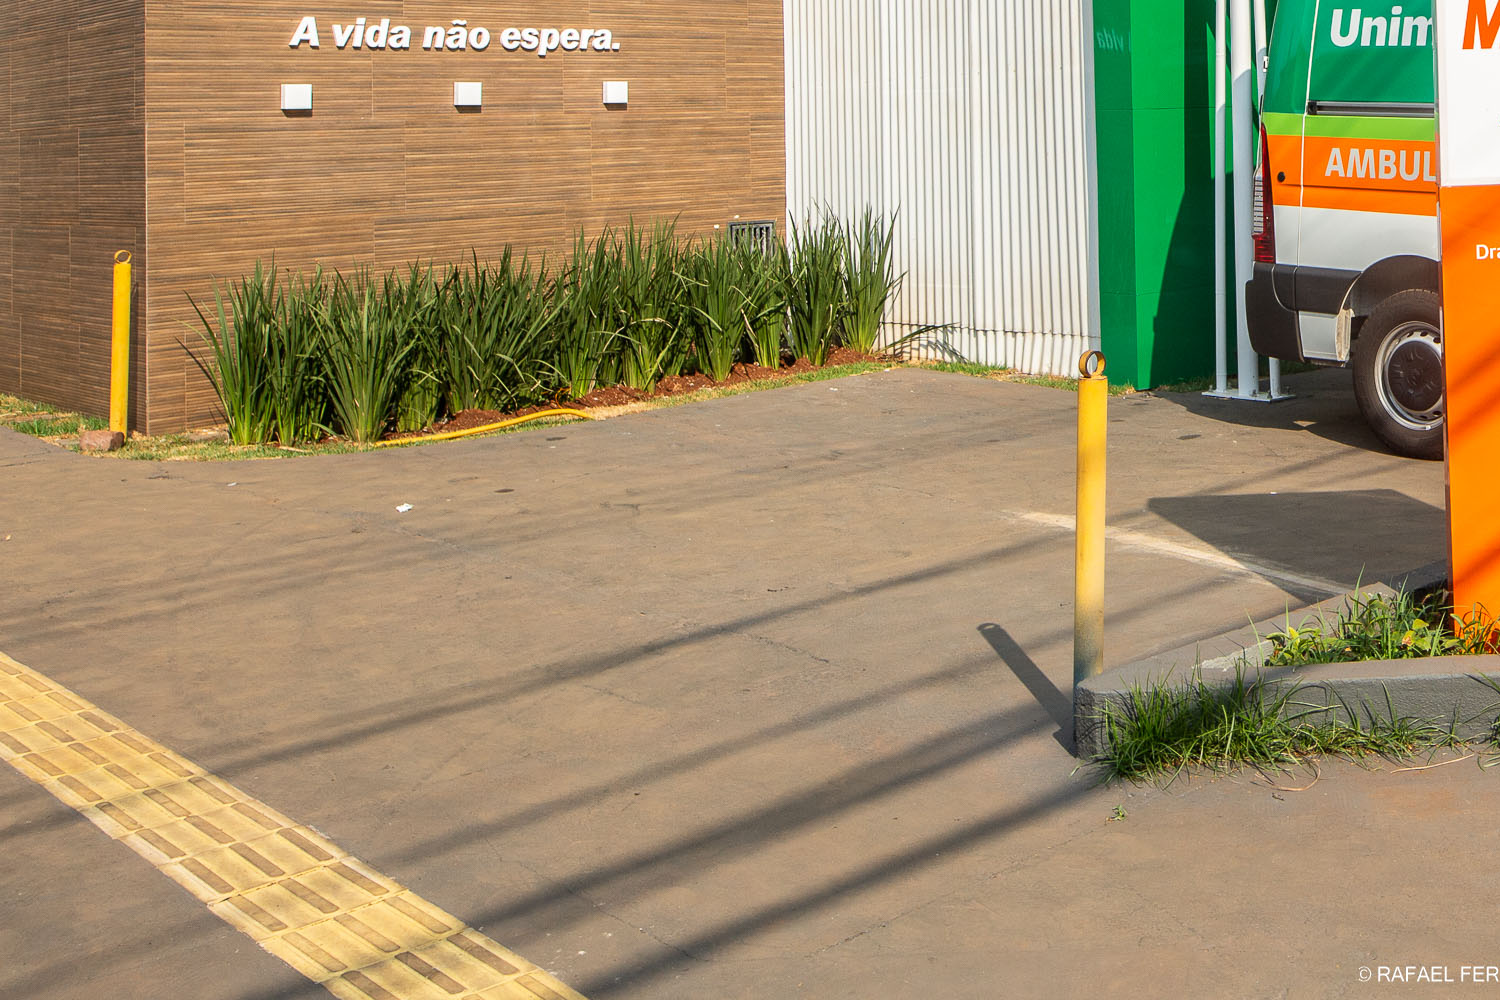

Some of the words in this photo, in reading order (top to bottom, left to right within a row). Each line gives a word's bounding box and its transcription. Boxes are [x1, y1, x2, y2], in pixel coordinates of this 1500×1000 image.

[289, 16, 320, 49] A
[331, 17, 411, 50] vida
[422, 18, 490, 50] não
[500, 26, 621, 58] espera.
